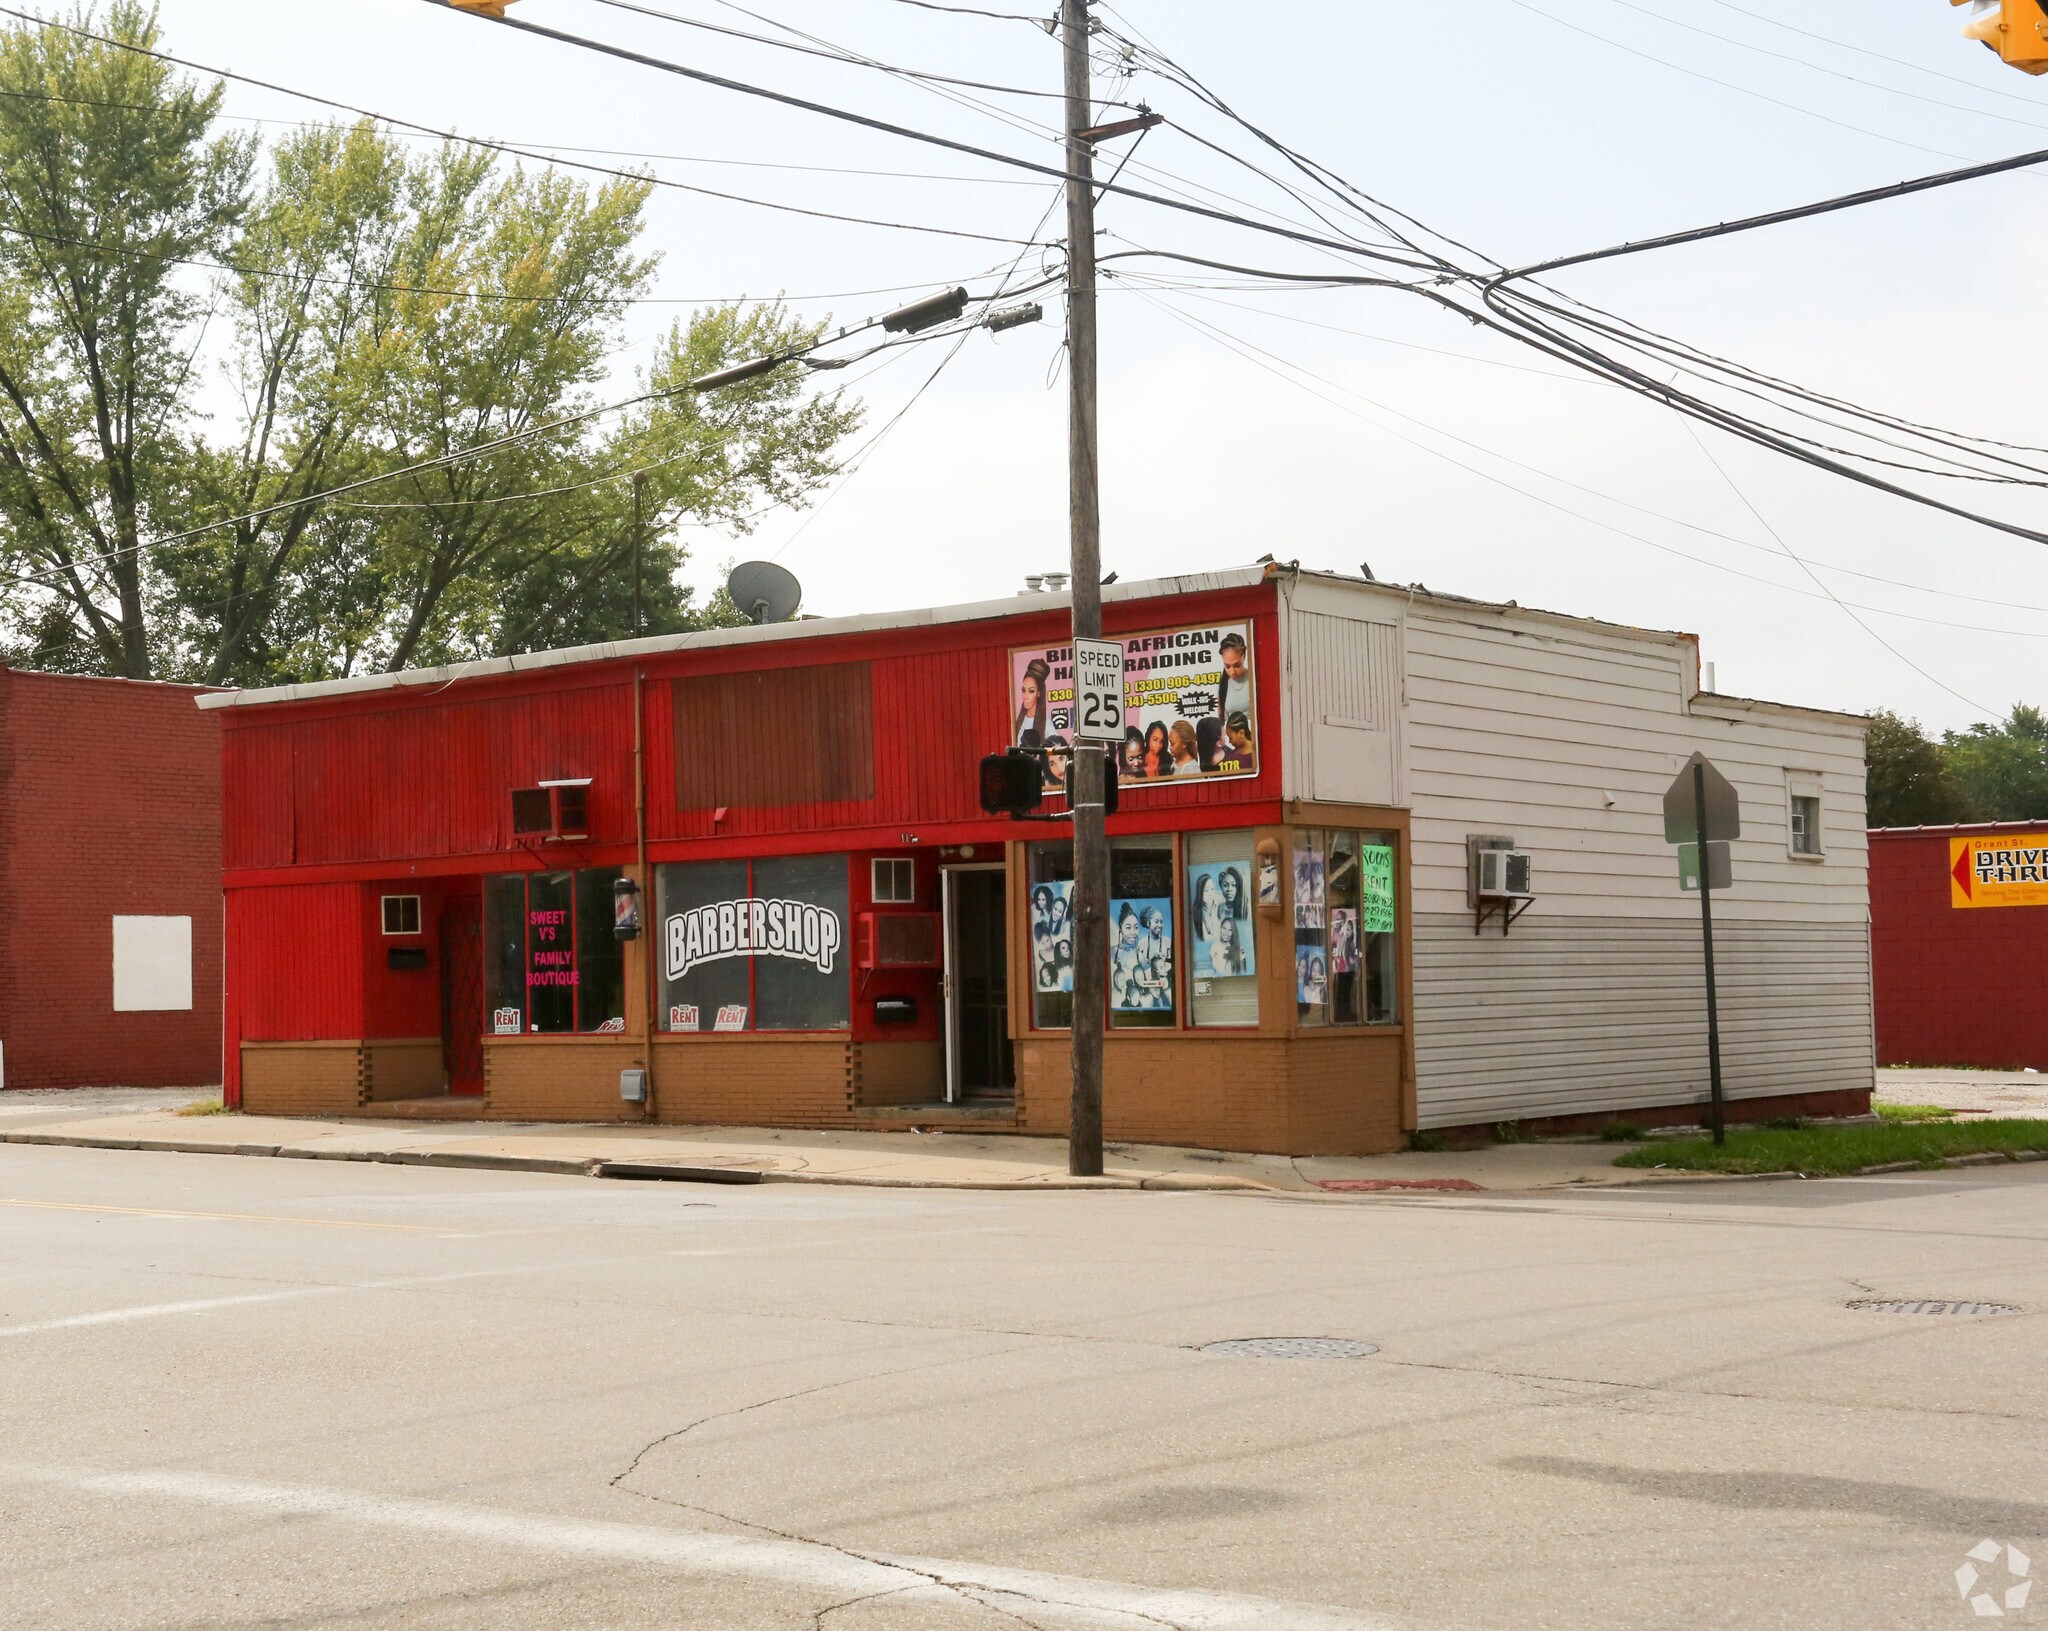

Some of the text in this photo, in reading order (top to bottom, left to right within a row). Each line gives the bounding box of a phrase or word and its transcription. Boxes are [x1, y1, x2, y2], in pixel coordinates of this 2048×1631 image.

[1127, 630, 1219, 653] AFRICAN
[1080, 651, 1120, 668] SPEED
[1124, 650, 1212, 672] RAIDING
[1084, 672, 1116, 688] LIMIT
[1134, 678, 1165, 694] (330)
[1166, 671, 1222, 689] 906-4497
[1083, 692, 1120, 728] 25
[1183, 705, 1210, 715] WELCOME
[1975, 839, 2028, 849] Grant St.
[1119, 871, 1162, 890] OPEN
[1363, 873, 1389, 891] RENT
[530, 910, 566, 925] SWEET
[538, 927, 556, 941] V'S
[665, 898, 840, 981] BARBERSHOP
[534, 951, 572, 966] FAMILY
[526, 971, 580, 986] BOUTIQUE
[496, 1010, 519, 1026] RENT
[672, 1008, 697, 1024] RENT
[718, 1008, 746, 1024] RENT
